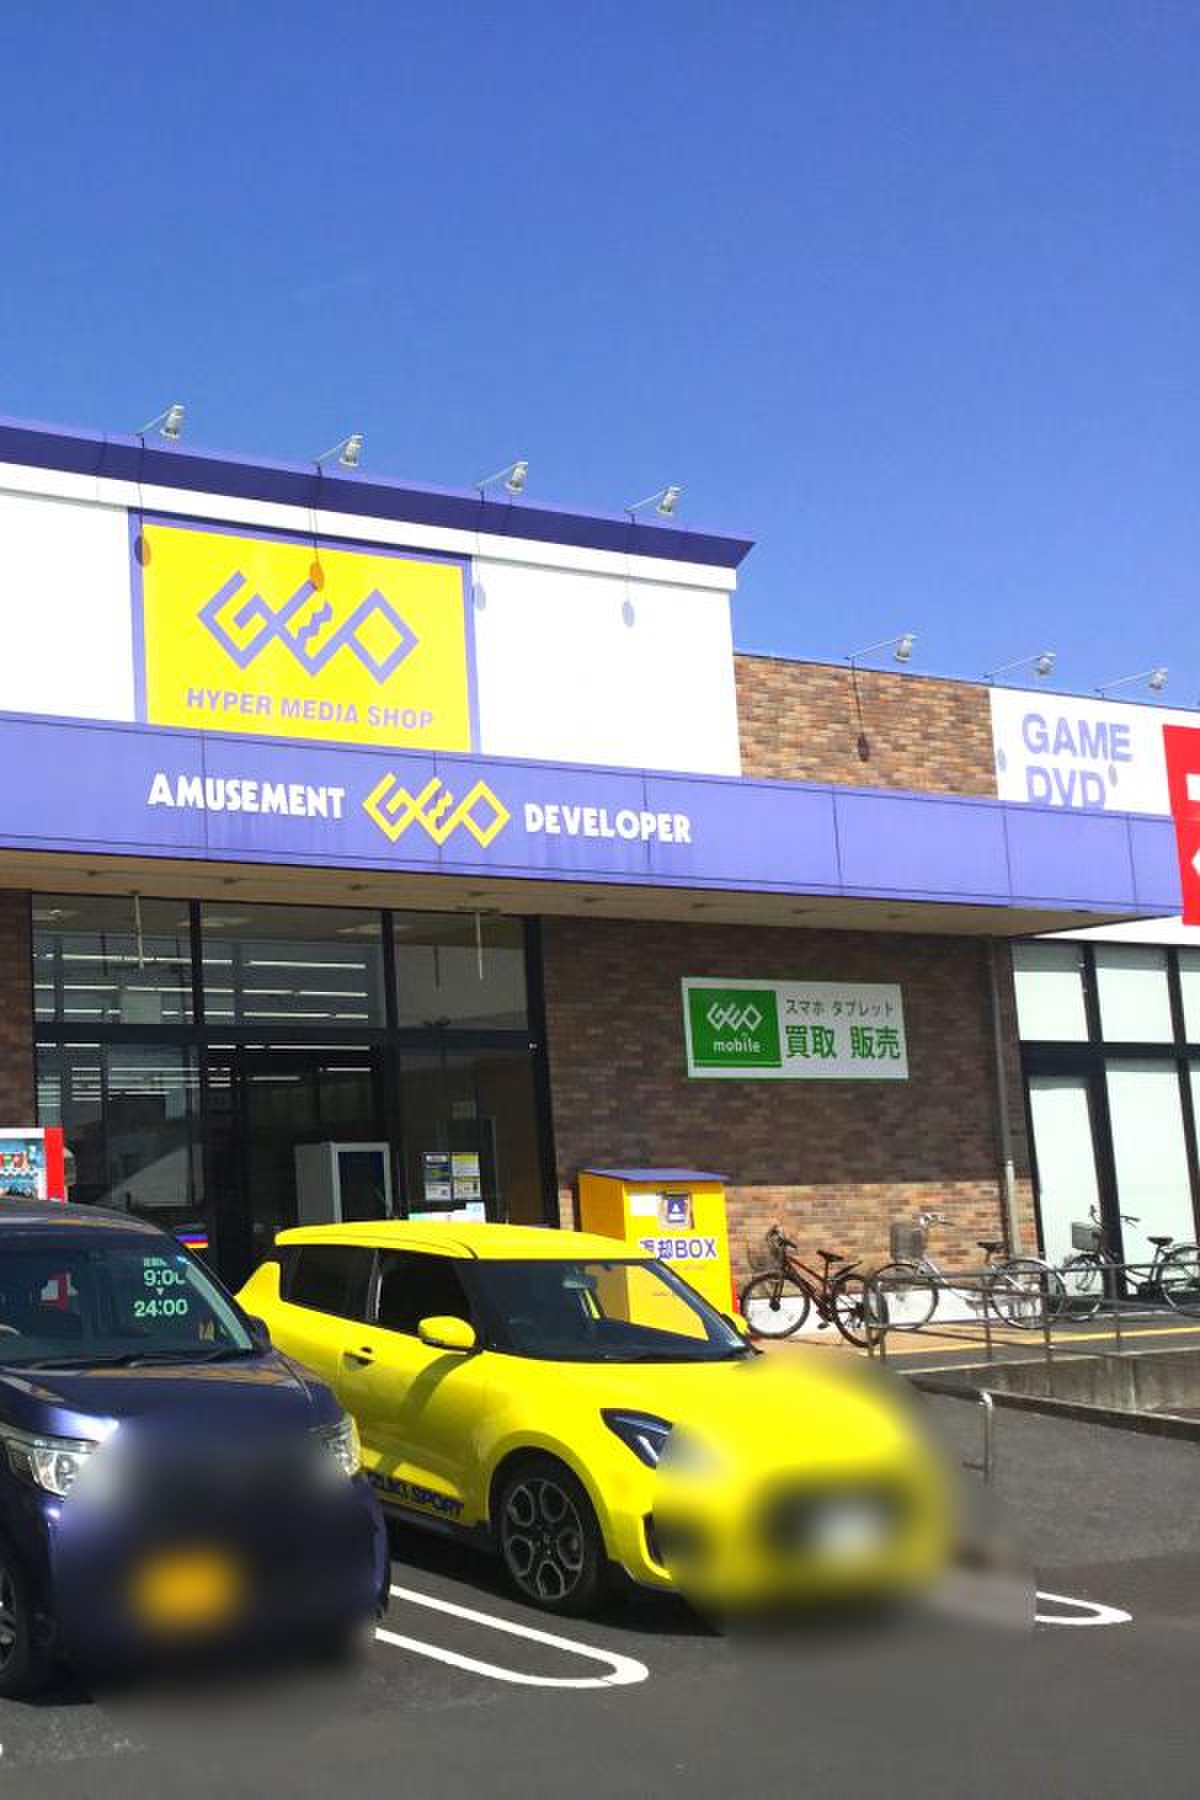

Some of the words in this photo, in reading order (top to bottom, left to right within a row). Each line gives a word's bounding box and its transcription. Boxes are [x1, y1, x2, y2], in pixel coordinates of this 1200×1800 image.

[186, 687, 272, 716] HYPER
[281, 698, 359, 724] MEDIA
[367, 705, 434, 730] SHOP
[1021, 713, 1133, 762] GAME
[1025, 765, 1107, 810] DVD
[147, 772, 345, 818] AMUSEMENT
[524, 802, 692, 844] DEVELOPER
[785, 999, 824, 1016] スマホ
[833, 1000, 894, 1018] タブレット
[713, 1036, 761, 1053] mobile
[785, 1024, 837, 1059] 買取
[850, 1025, 900, 1060] 販売
[133, 1299, 188, 1317] 24:00
